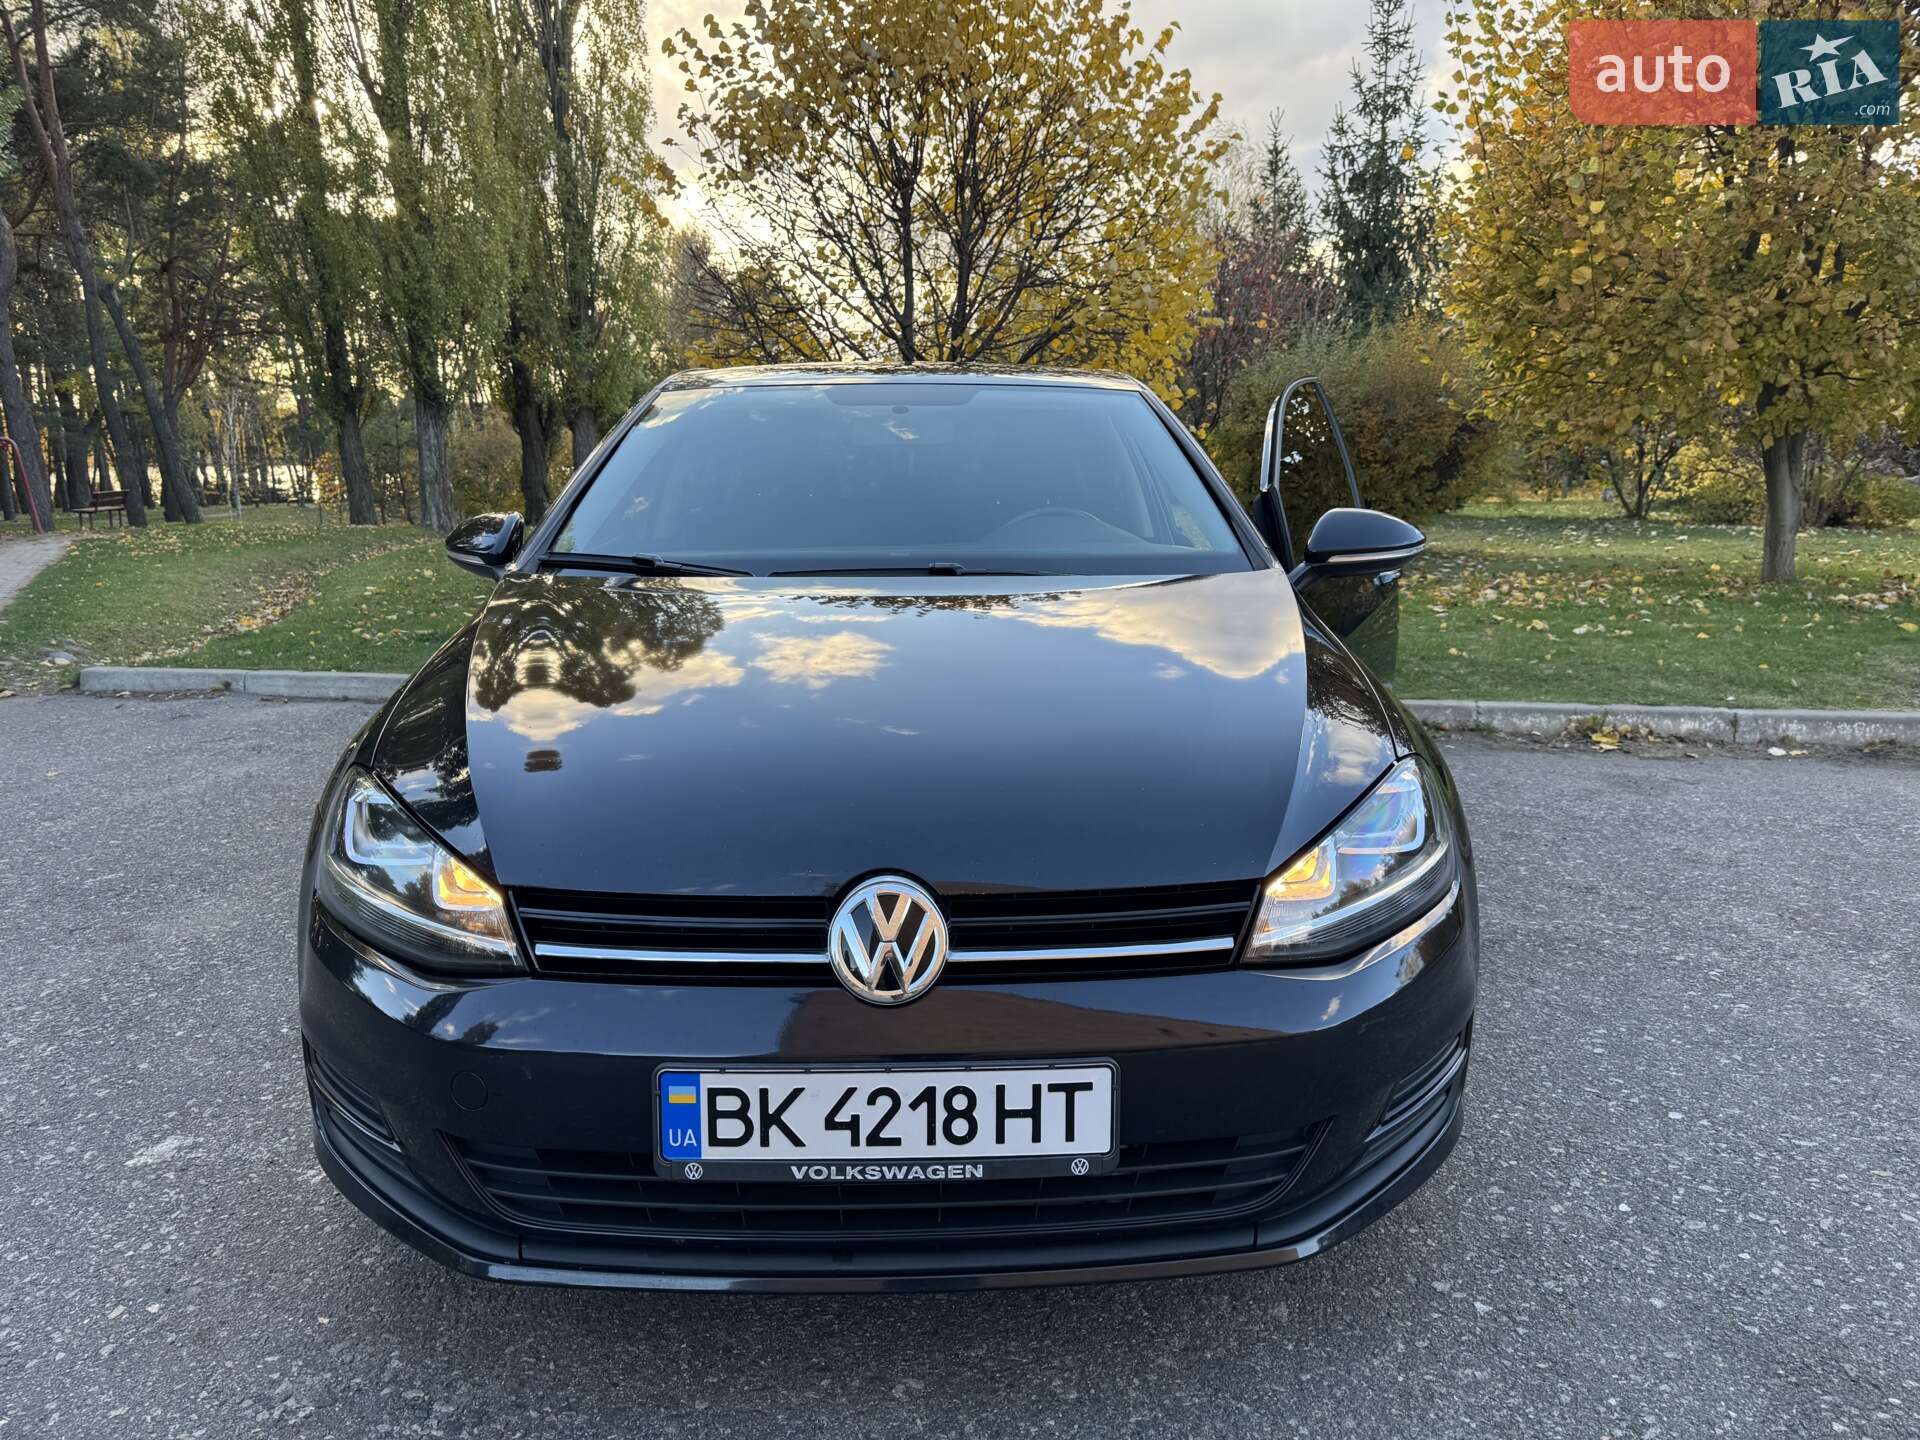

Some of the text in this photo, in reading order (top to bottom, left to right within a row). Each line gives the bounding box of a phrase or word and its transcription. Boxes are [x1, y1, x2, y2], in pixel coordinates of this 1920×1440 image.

[706, 1081, 1093, 1148] BK 4218 HT
[668, 1129, 698, 1148] UA
[790, 1164, 983, 1181] VOLKSWAGEN
